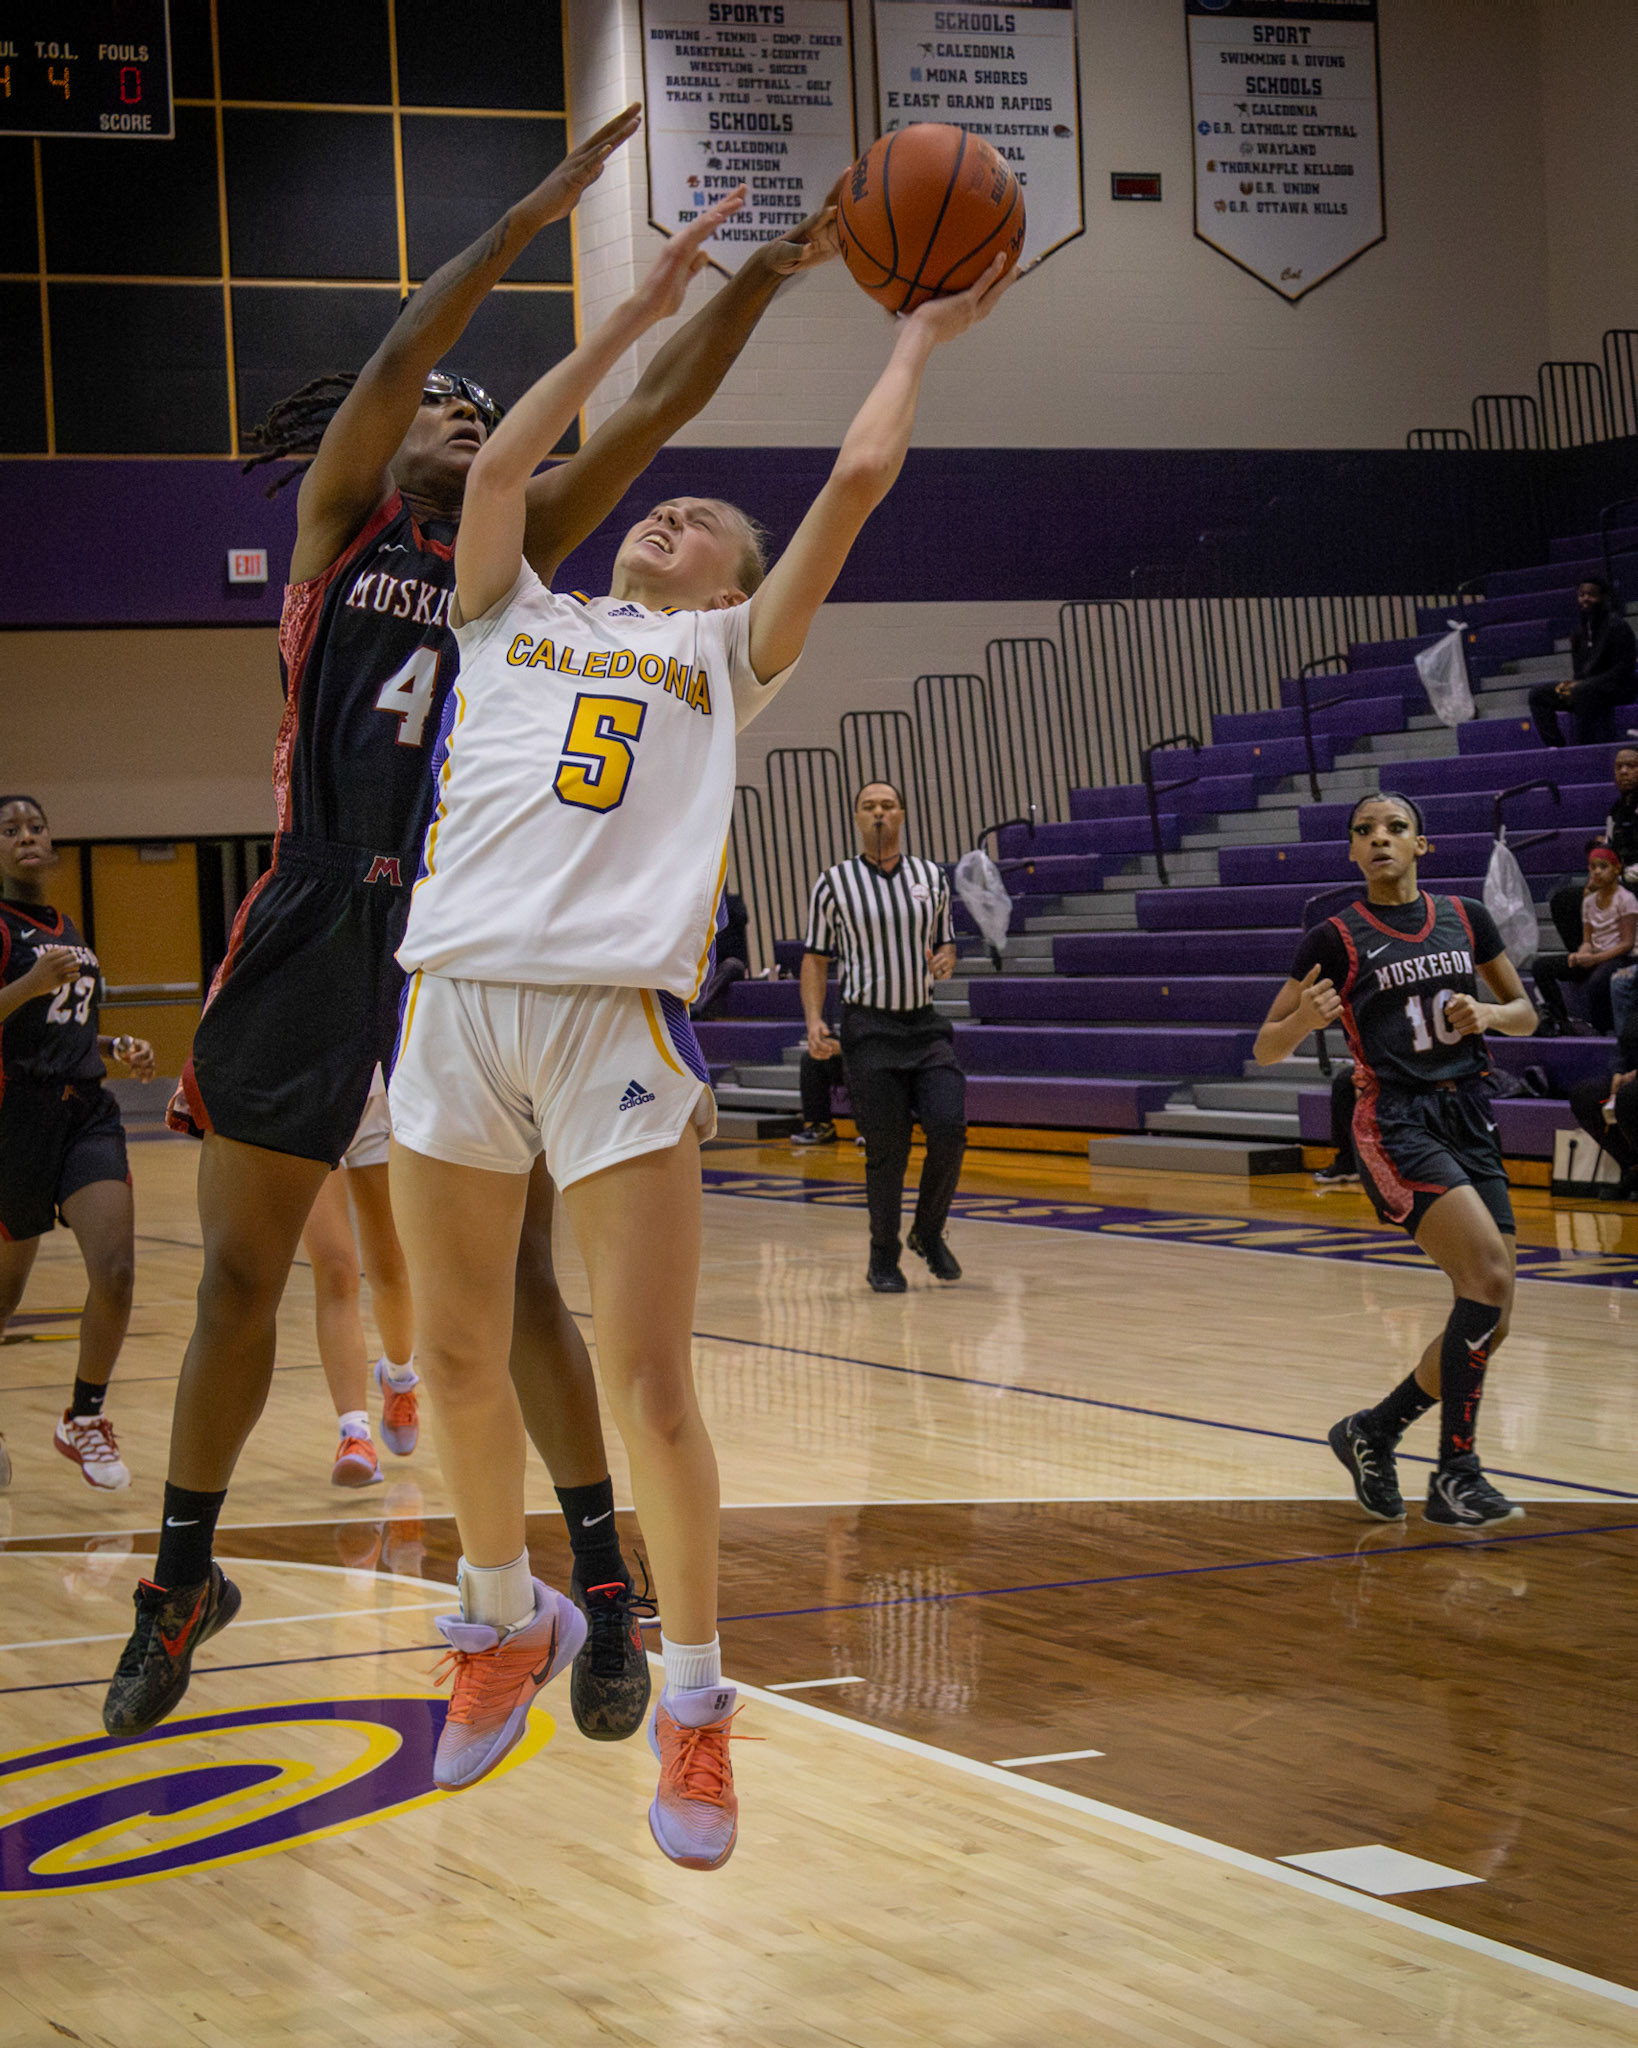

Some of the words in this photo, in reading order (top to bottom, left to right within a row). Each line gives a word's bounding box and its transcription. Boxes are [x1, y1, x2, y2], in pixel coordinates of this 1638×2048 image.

[709, 3, 785, 23] SPORTS
[935, 11, 1016, 32] SCHOOLS
[651, 29, 699, 41] BOWLING
[716, 32, 757, 43] TENNIS
[809, 35, 843, 46] CHEER
[1253, 24, 1312, 44] SPORT
[35, 41, 79, 60] T.O.L.
[99, 44, 149, 61] FOULS
[675, 45, 745, 58] BASKETBALL
[936, 43, 1015, 60] CALEDONIA
[690, 61, 753, 74] WRESTLING
[769, 64, 808, 75] SOCCER
[1220, 52, 1286, 66] SWIMMING
[1291, 54, 1299, 66] &
[1305, 55, 1345, 68] DIVING
[48, 66, 70, 100] 4
[119, 66, 142, 104] 0
[666, 75, 721, 88] BASEBALL
[737, 78, 791, 90] SOFTBALL
[807, 80, 832, 91] GOLF
[926, 68, 968, 83] MONA
[974, 69, 1028, 86] SHORES
[1246, 76, 1322, 95] SCHOOLS
[666, 91, 702, 102] TRACK
[719, 92, 750, 104] FIELD
[766, 94, 833, 106] VOLLEYBALL
[903, 93, 940, 108] EAST
[947, 94, 994, 110] GRAND
[1001, 96, 1052, 111] RAPIDS
[1252, 103, 1318, 117] CALEDONIA
[100, 113, 152, 131] SCORE
[709, 112, 793, 132] SCHOOLS
[1240, 123, 1298, 136] CATHOLIC
[1303, 125, 1357, 138] CENTRAL
[716, 140, 788, 154] CALEDONIA
[1257, 143, 1316, 156] WAYLAND
[725, 159, 781, 172] JENISON
[1220, 162, 1298, 175] THORNAPPLE
[1304, 163, 1354, 176] KELLOGG
[704, 175, 746, 188] BYRON
[752, 177, 803, 190] CENTER
[1284, 183, 1320, 194] UNION
[752, 194, 802, 207] SHORES
[1257, 202, 1309, 214] OTTAWA
[1314, 203, 1348, 215] HILLS
[506, 633, 712, 715] CALEDONIA
[373, 645, 441, 748] 4
[552, 692, 648, 814] 5
[363, 855, 403, 887] M
[1374, 950, 1473, 991] MUSKEGON
[1405, 989, 1463, 1052] 10
[619, 1092, 656, 1111] adidas
